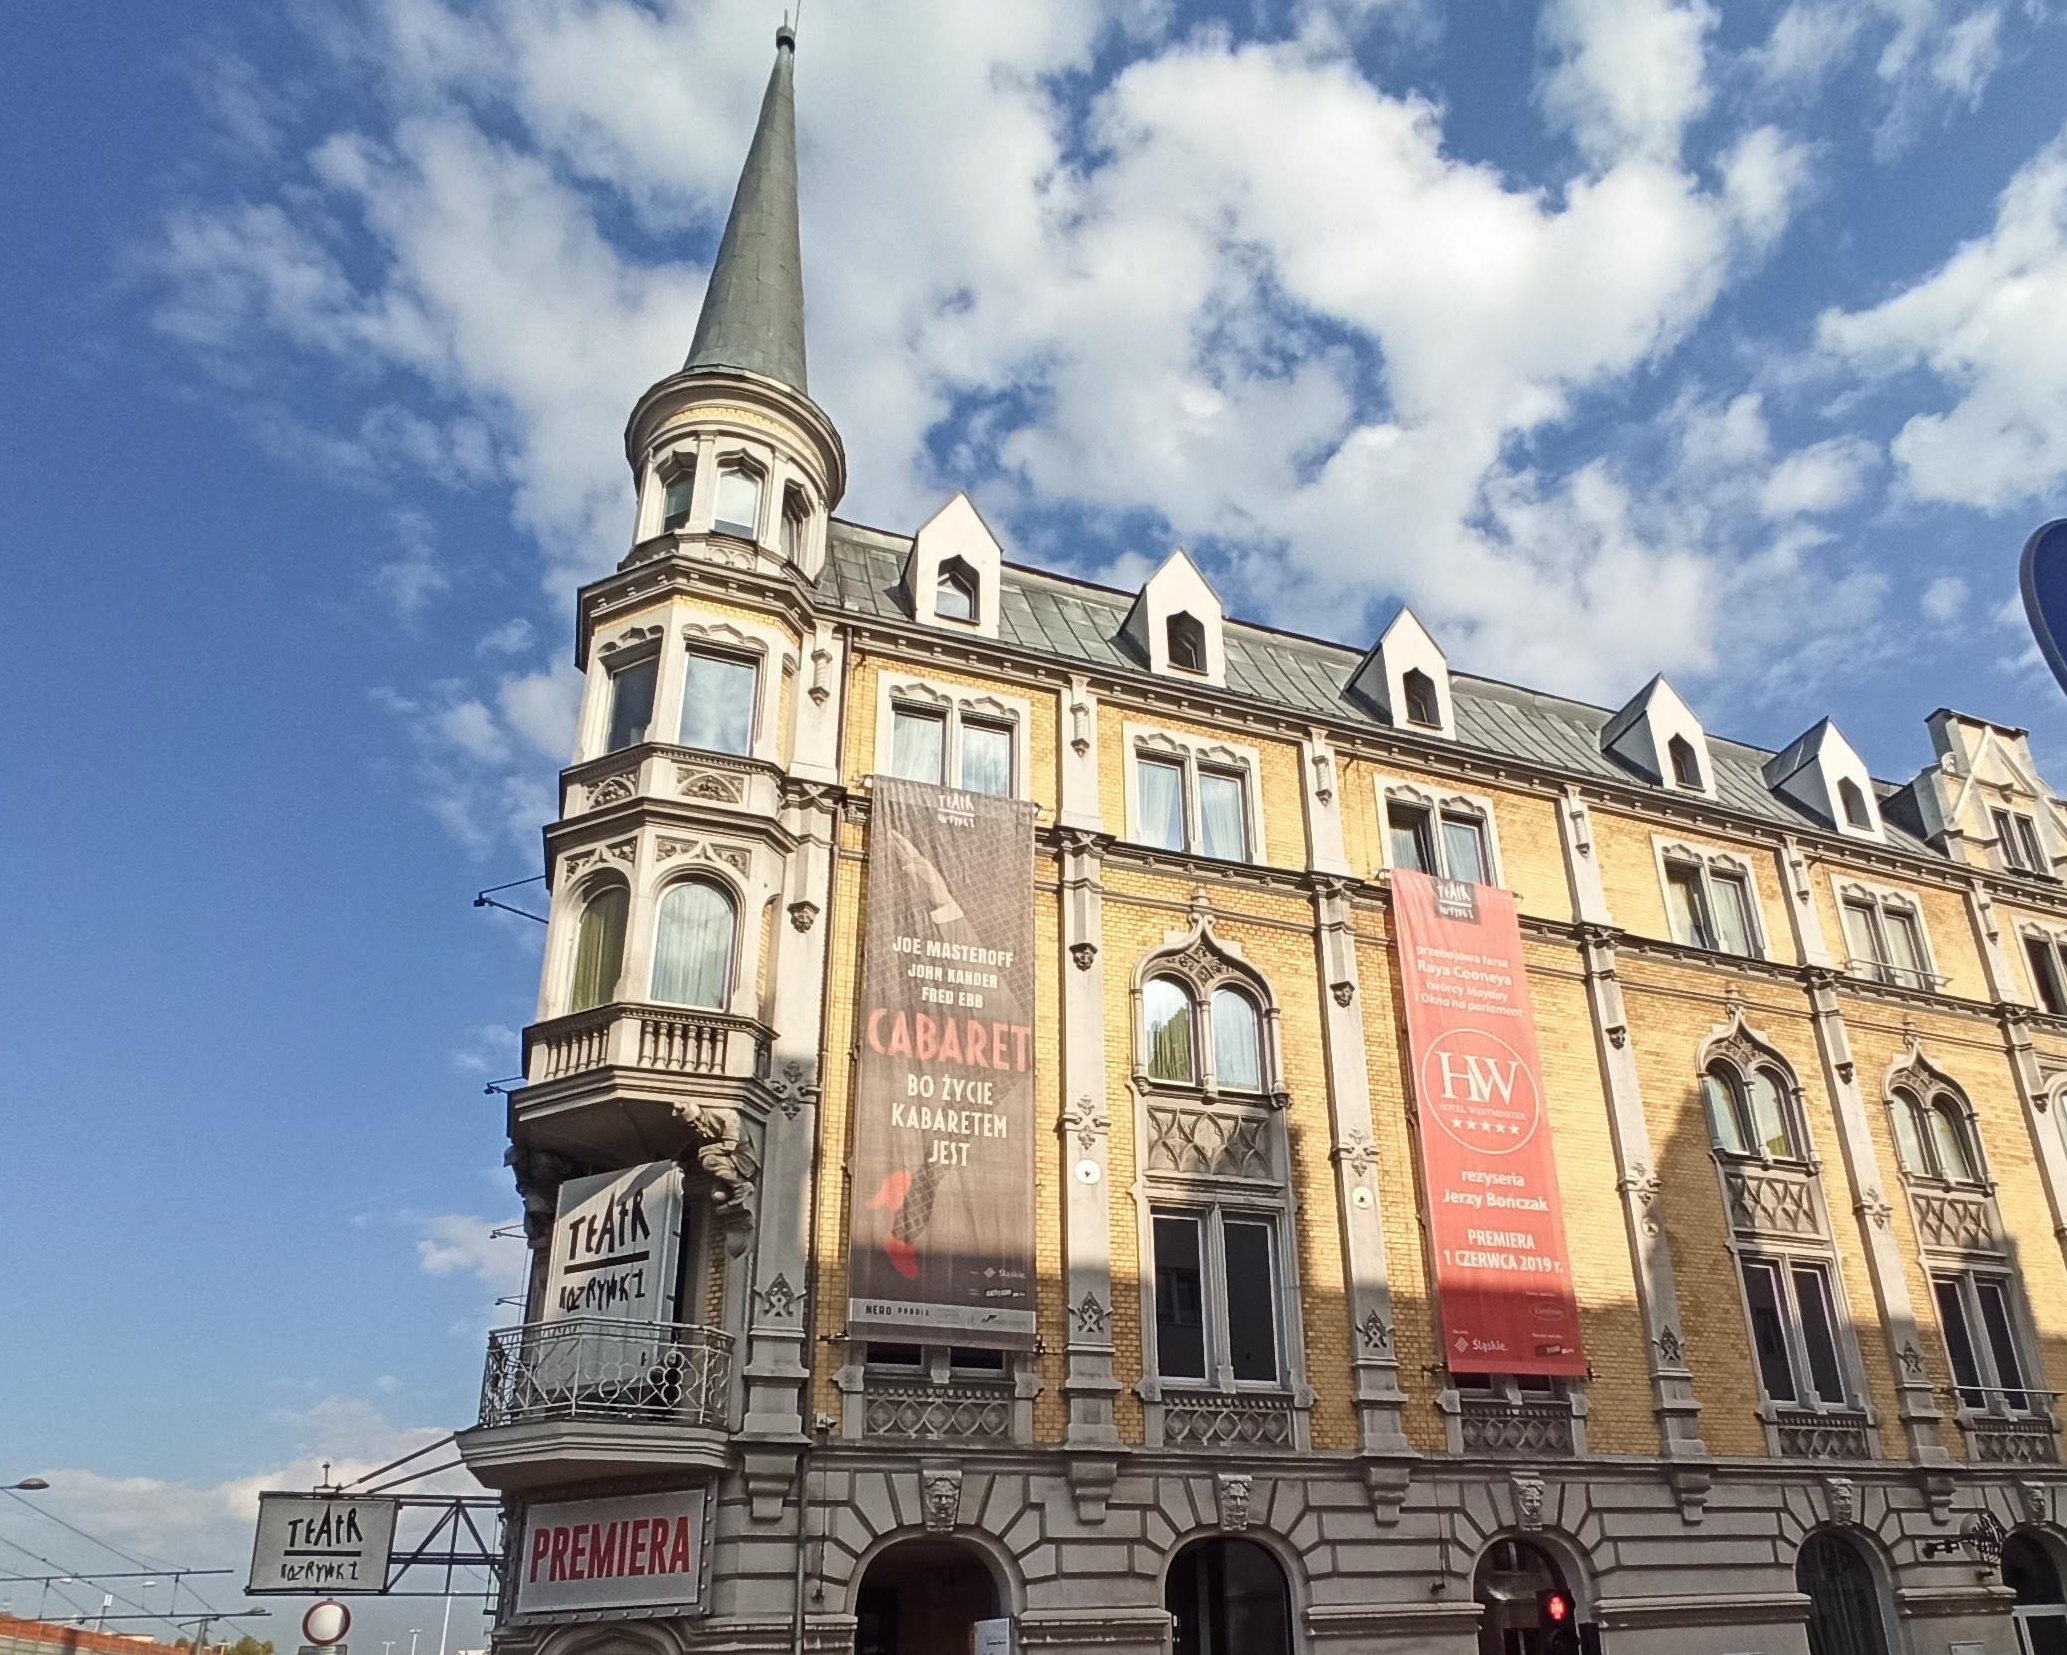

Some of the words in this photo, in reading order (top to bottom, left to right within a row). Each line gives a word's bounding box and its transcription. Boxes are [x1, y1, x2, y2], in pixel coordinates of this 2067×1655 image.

[892, 936, 922, 955] JOE
[926, 940, 1014, 968] MASTEROFF
[1416, 946, 1480, 964] przebojowa
[1482, 954, 1509, 968] farsa
[907, 963, 943, 981] JOHN
[947, 968, 998, 989] KANDER
[1417, 960, 1451, 977] Raya
[1453, 966, 1513, 987] Cooneya
[921, 986, 954, 1005] FRED
[958, 992, 983, 1008] EBB
[1421, 992, 1450, 1007] Okna
[1451, 999, 1467, 1009] na
[1467, 1002, 1523, 1018] parlament
[1466, 986, 1509, 1003] Mayday
[868, 1008, 1032, 1072] CABARET
[907, 1073, 934, 1098] BO
[942, 1074, 993, 1106] ŻYCIE
[1435, 1050, 1520, 1106] HW
[891, 1102, 1007, 1138] KABARETEM
[1440, 1104, 1467, 1114] HOTEL
[1468, 1106, 1526, 1120] WESTMINSTER
[928, 1139, 970, 1166] JEST
[1461, 1169, 1525, 1187] reżyseria
[1443, 1188, 1482, 1209] Jerzy
[1486, 1191, 1549, 1212] Bończak
[569, 1187, 650, 1260] TEATR
[1467, 1228, 1536, 1250] PREMIERA
[1443, 1249, 1452, 1266] 1
[1455, 1250, 1518, 1270] CZERWCA
[1519, 1255, 1551, 1273] 2019
[1553, 1261, 1565, 1274] r.
[865, 1305, 892, 1316] NERO
[288, 1503, 363, 1548] TEATR
[529, 1516, 690, 1583] PREMIERA
